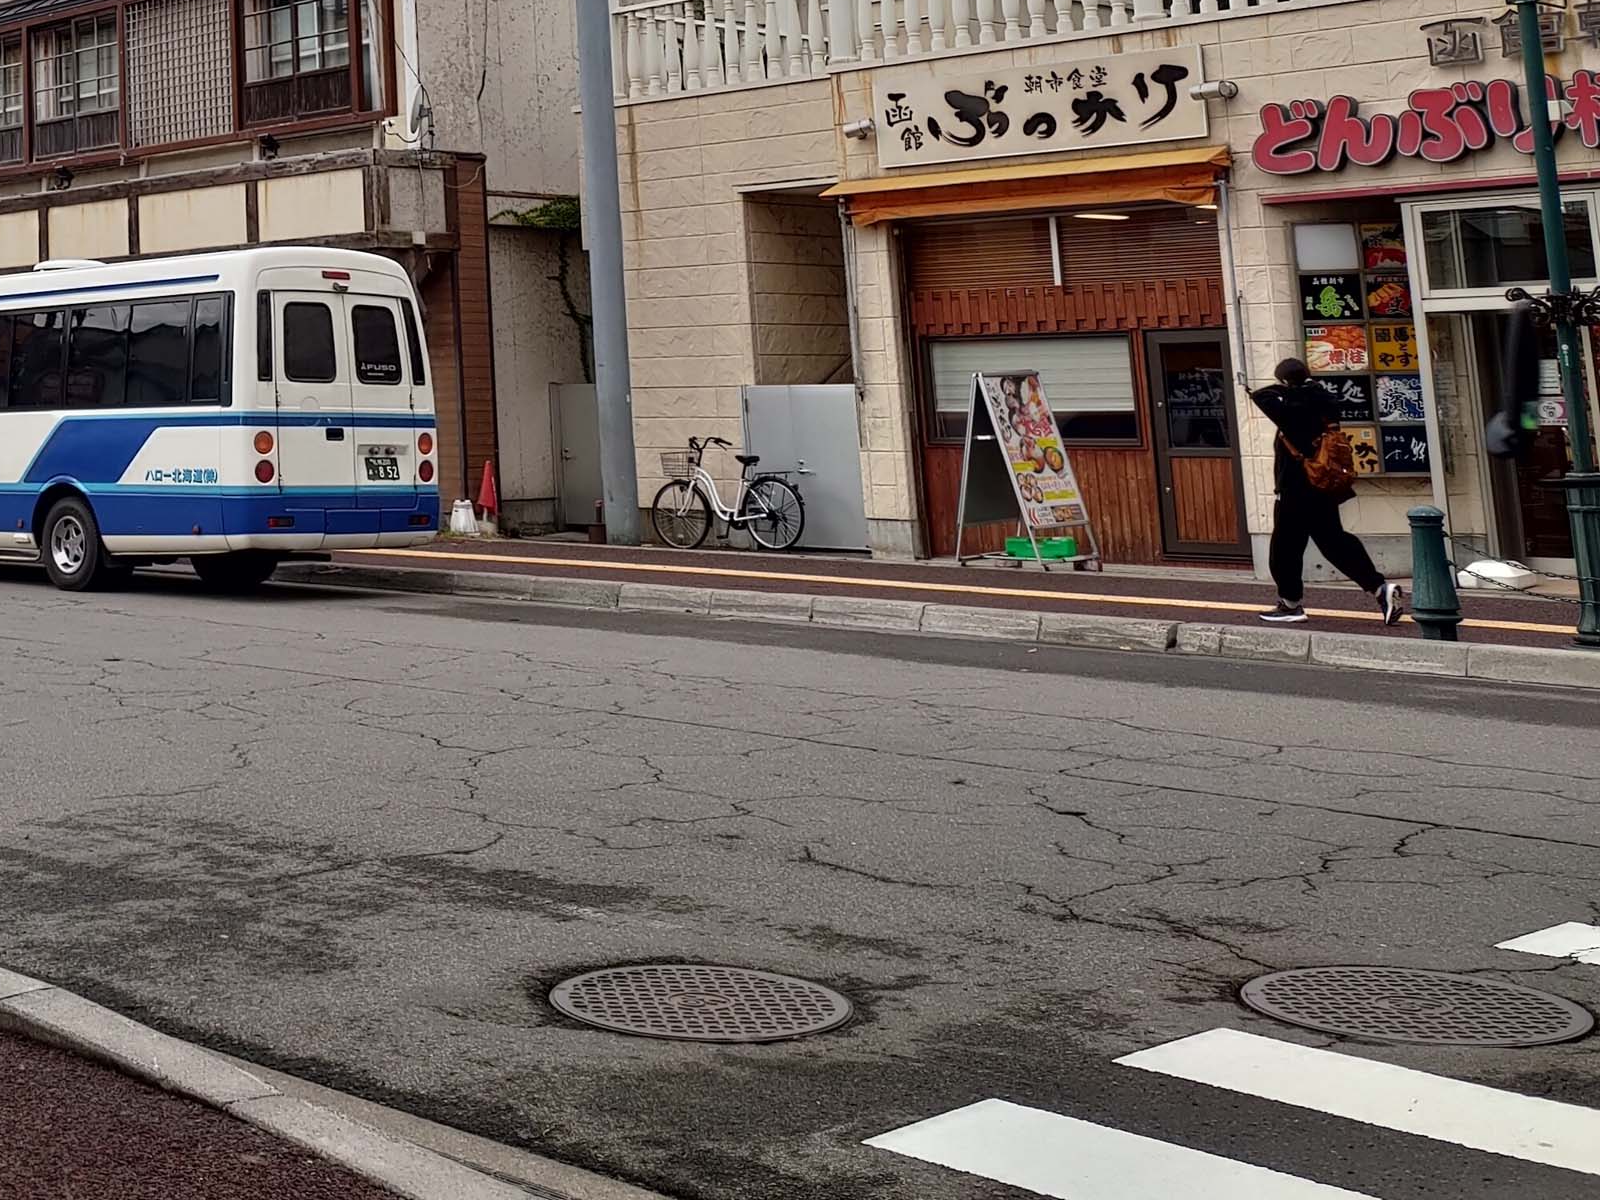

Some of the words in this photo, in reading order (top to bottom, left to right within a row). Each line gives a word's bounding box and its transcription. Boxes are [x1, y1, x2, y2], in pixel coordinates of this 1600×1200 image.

[1420, 0, 1600, 67] 函館
[927, 64, 1190, 148] ぶっかけ
[1023, 65, 1109, 95] 朝市食堂
[884, 92, 925, 152] 函館
[367, 363, 397, 372] FUSO
